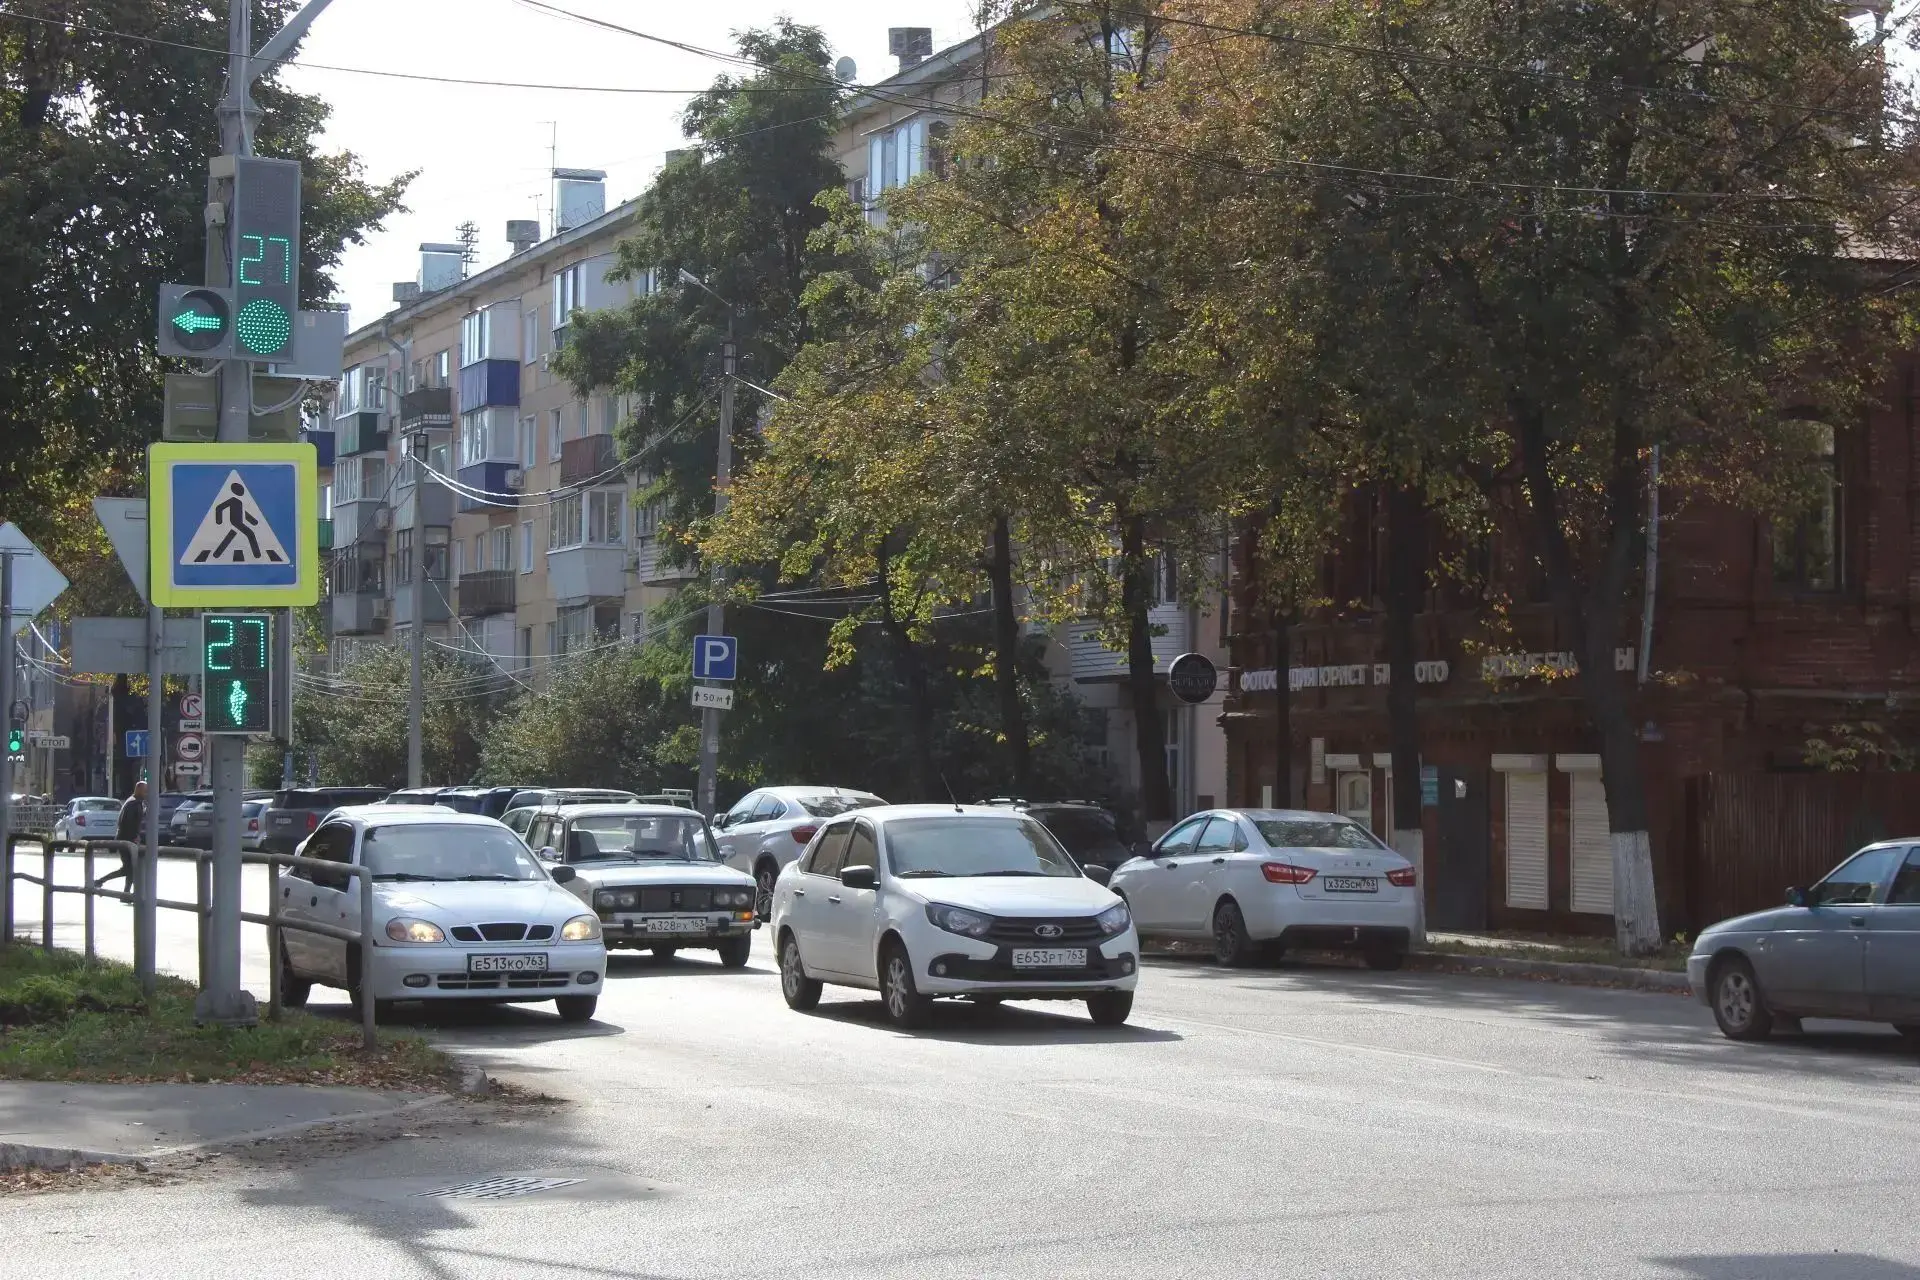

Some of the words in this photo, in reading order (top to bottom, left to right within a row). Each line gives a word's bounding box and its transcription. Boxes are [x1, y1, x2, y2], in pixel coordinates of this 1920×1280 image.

[240, 234, 290, 284] 27
[208, 619, 264, 670] 27
[704, 640, 730, 675] P
[1240, 667, 1318, 691] ФОТОСДИЯ
[1319, 664, 1367, 687] ЮРИСТ
[703, 693, 715, 702] 50
